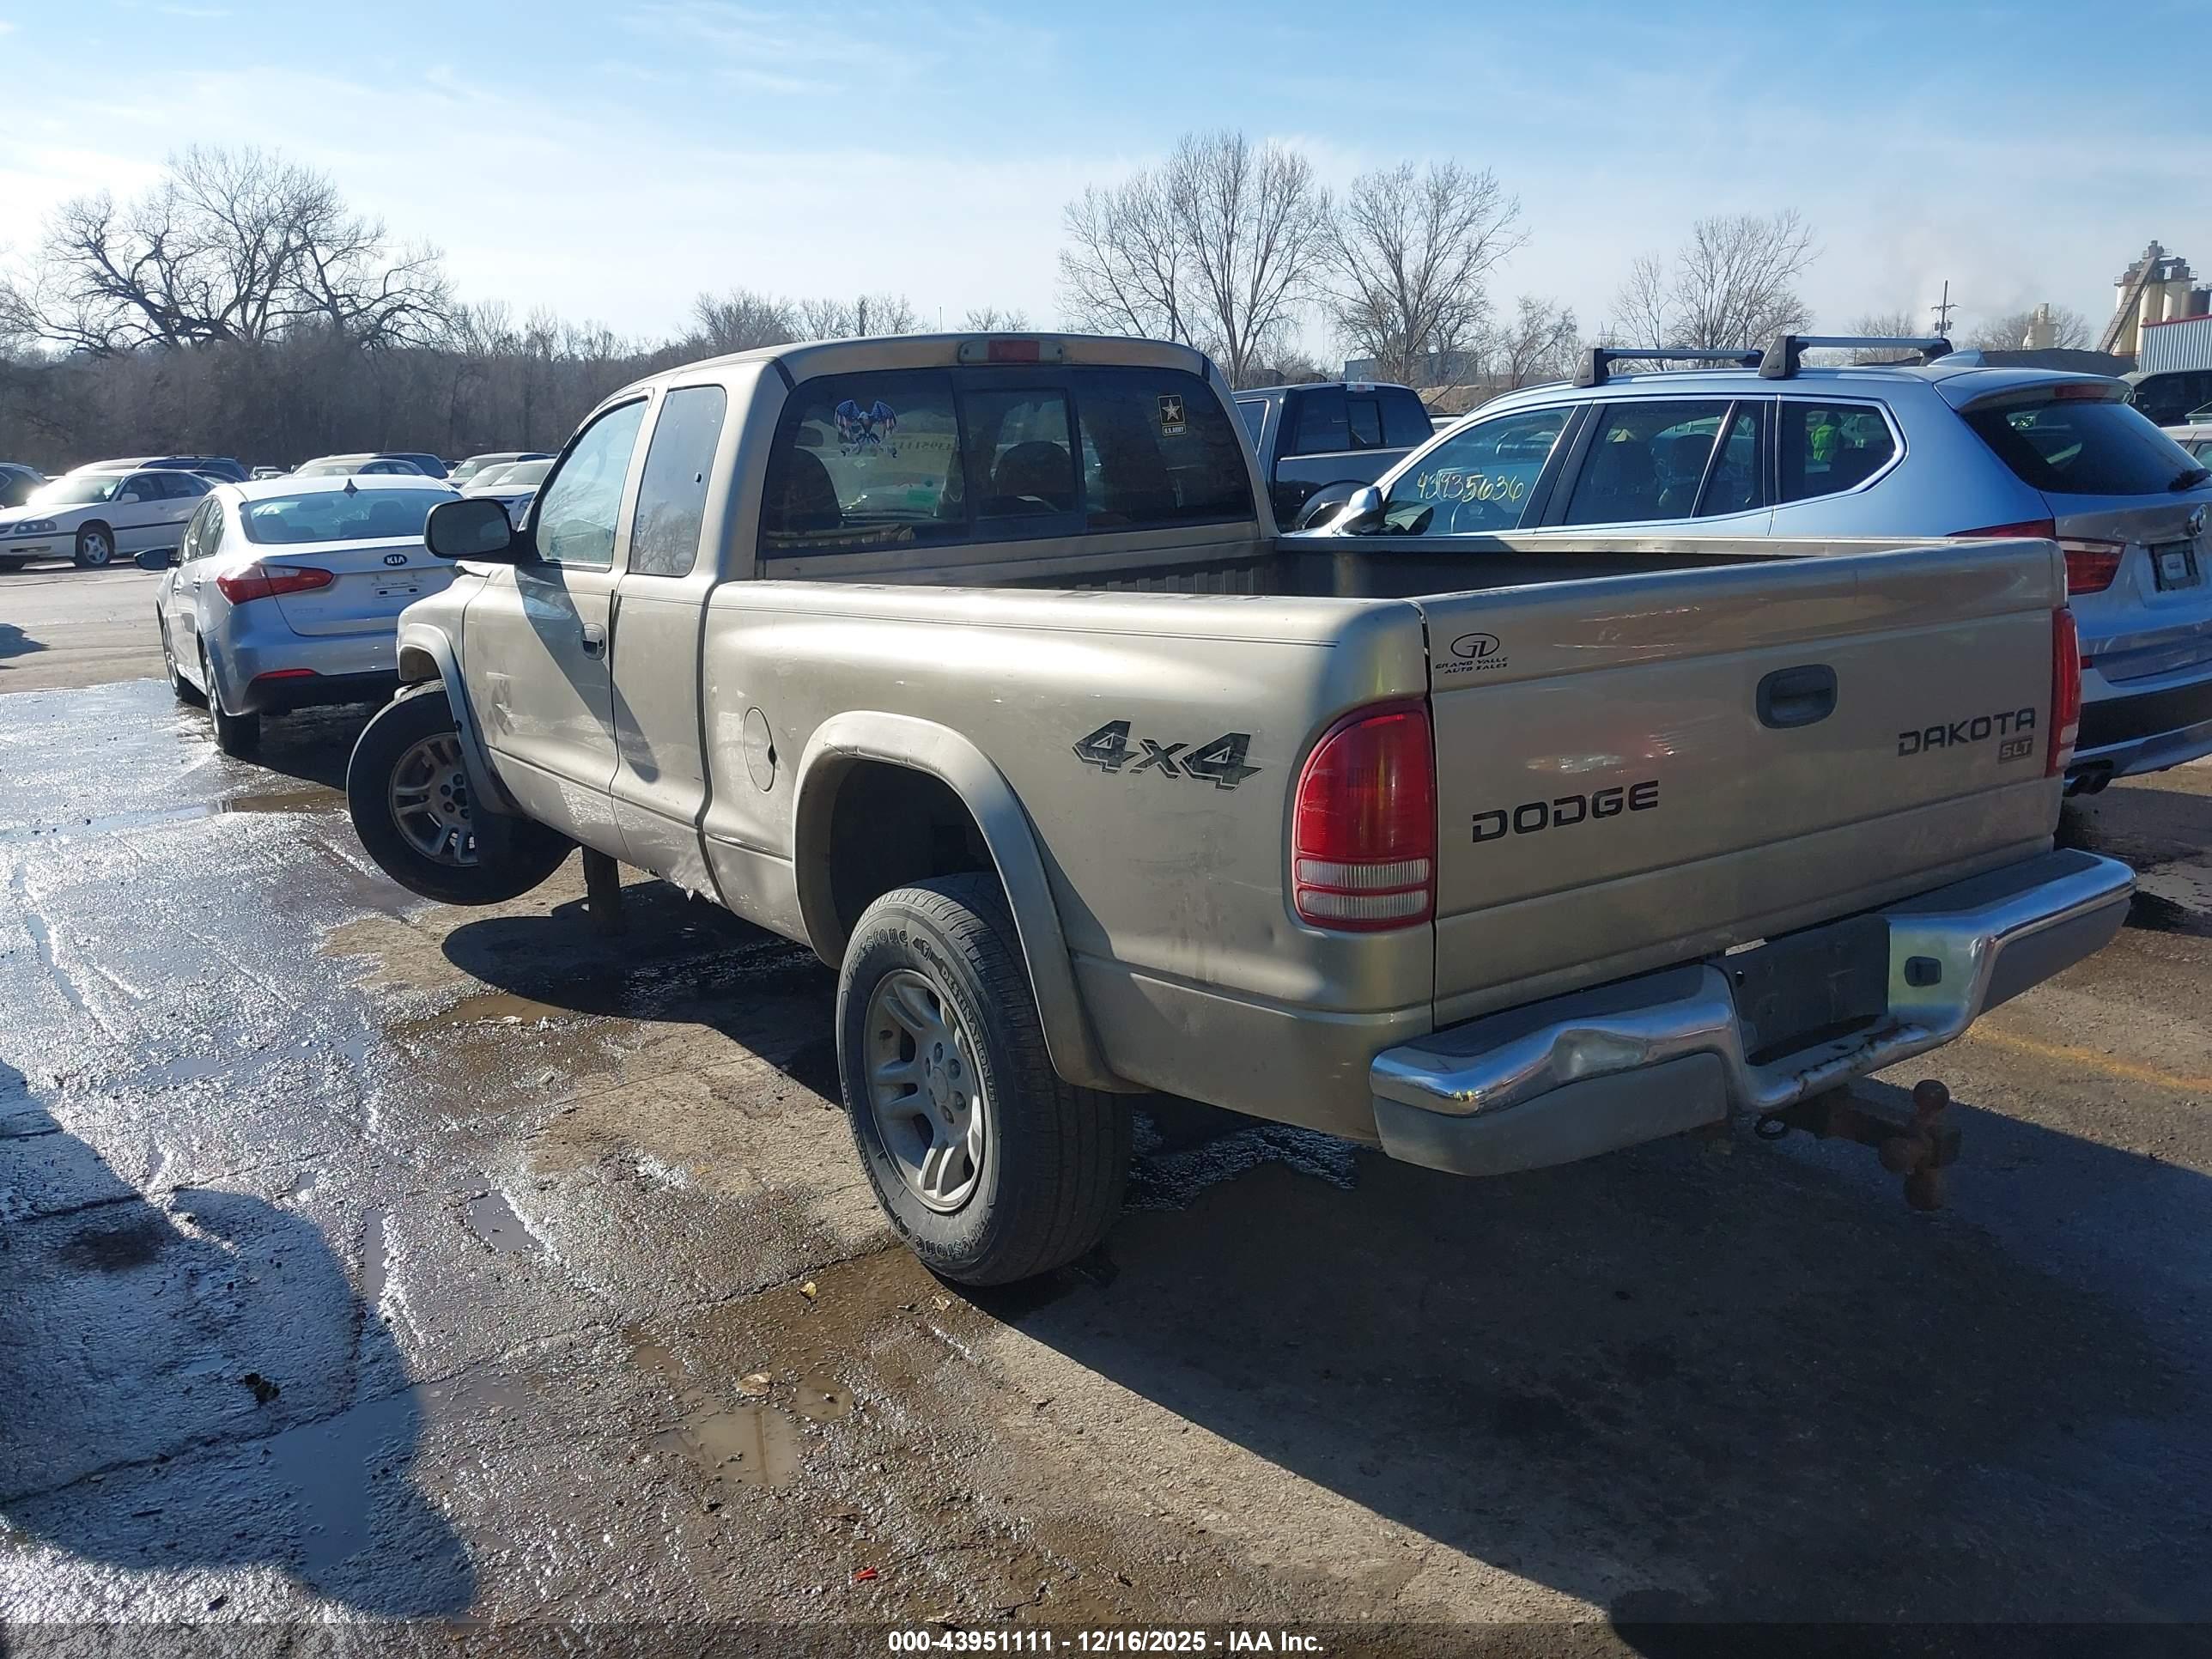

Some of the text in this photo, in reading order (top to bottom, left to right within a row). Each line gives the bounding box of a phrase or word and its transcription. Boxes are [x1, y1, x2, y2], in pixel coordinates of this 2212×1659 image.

[386, 556, 405, 564] KIA
[1435, 660, 1474, 669] GRAND
[1898, 708, 2036, 757] DAKOTA
[2000, 738, 2033, 761] SLT
[1472, 780, 1659, 842] DODGE
